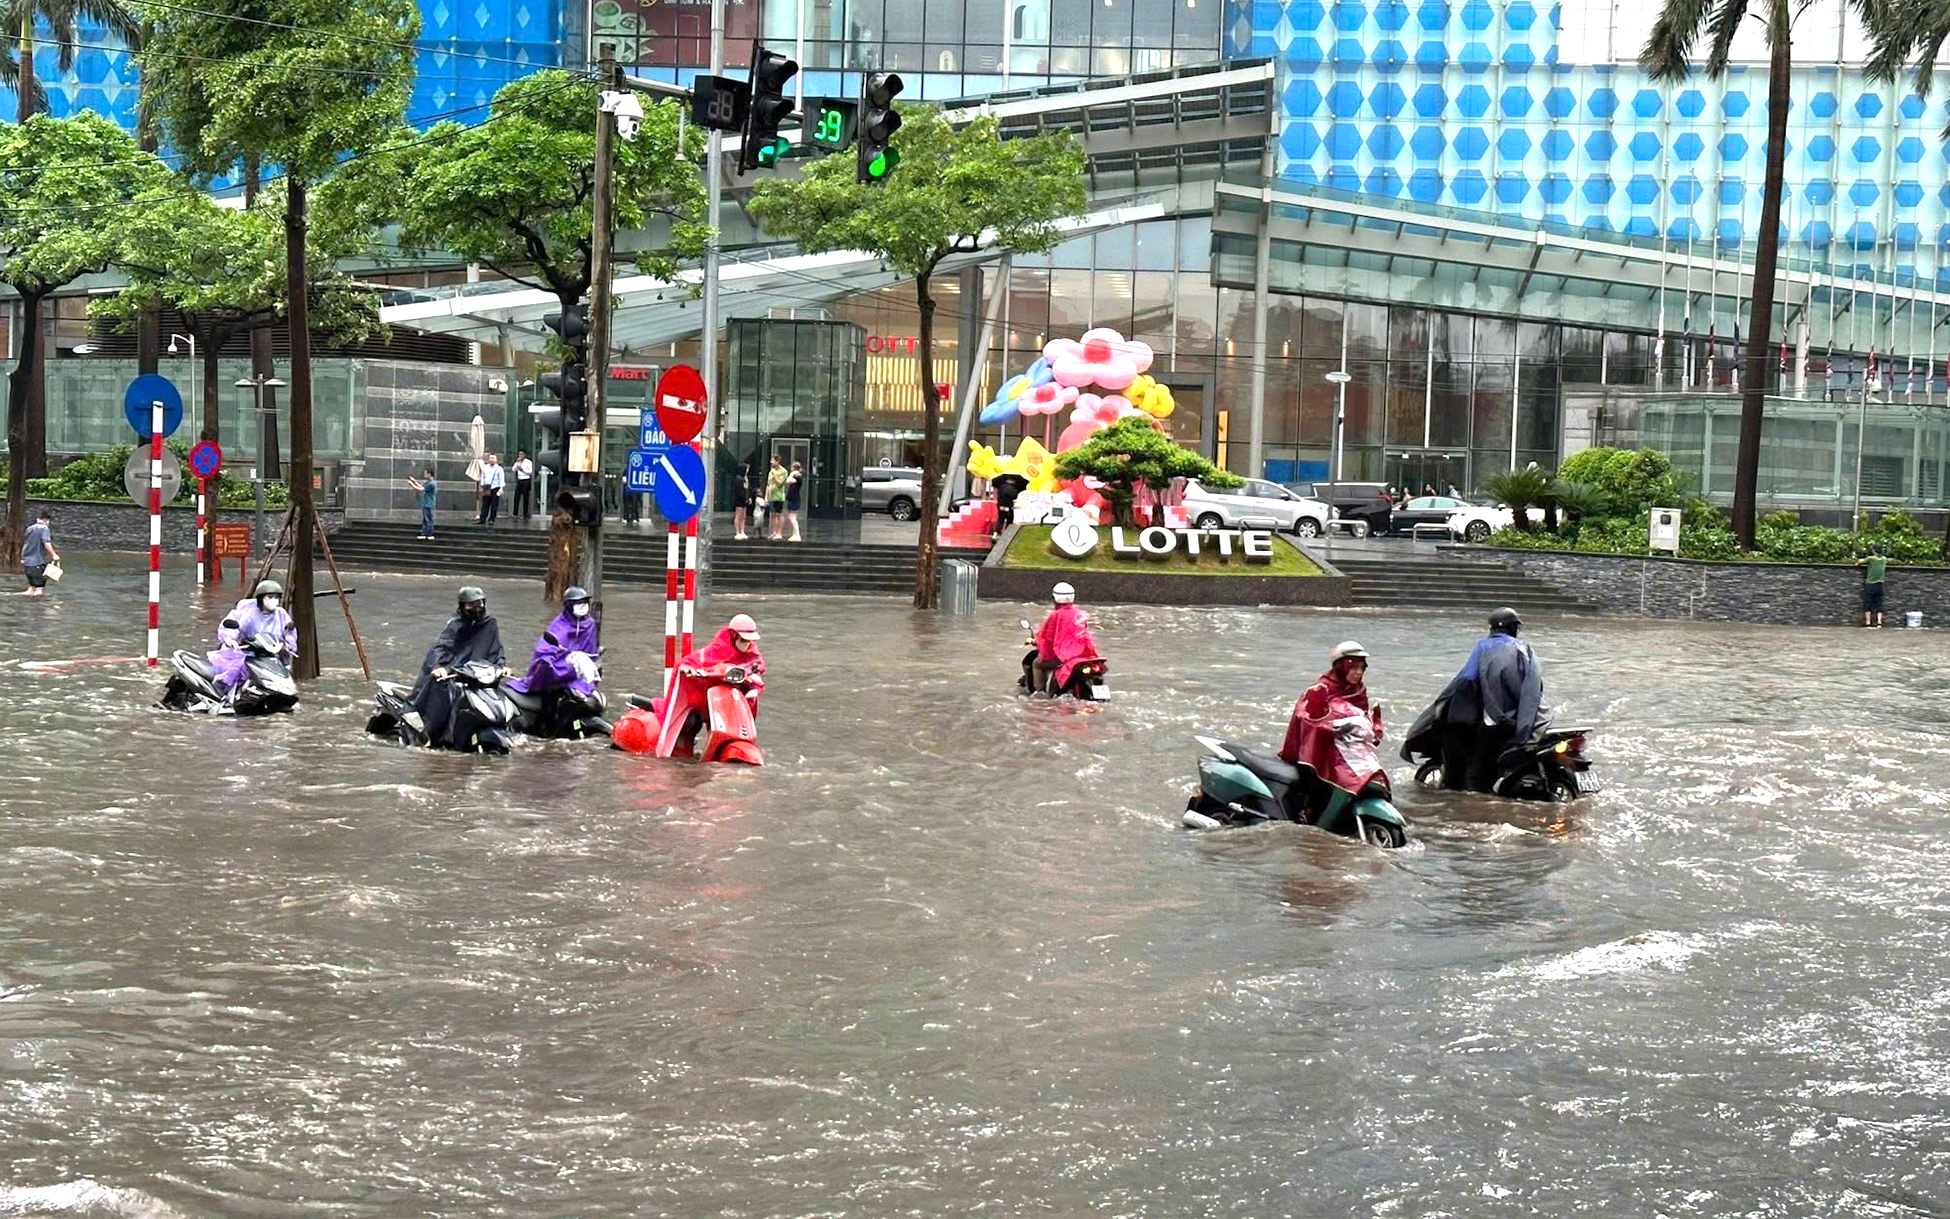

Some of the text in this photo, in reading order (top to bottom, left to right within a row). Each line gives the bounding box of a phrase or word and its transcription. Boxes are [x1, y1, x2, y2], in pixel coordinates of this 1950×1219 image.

[813, 107, 842, 142] 39
[866, 335, 919, 353] OTT
[610, 368, 648, 380] Mart
[1111, 526, 1274, 556] LOTTE
